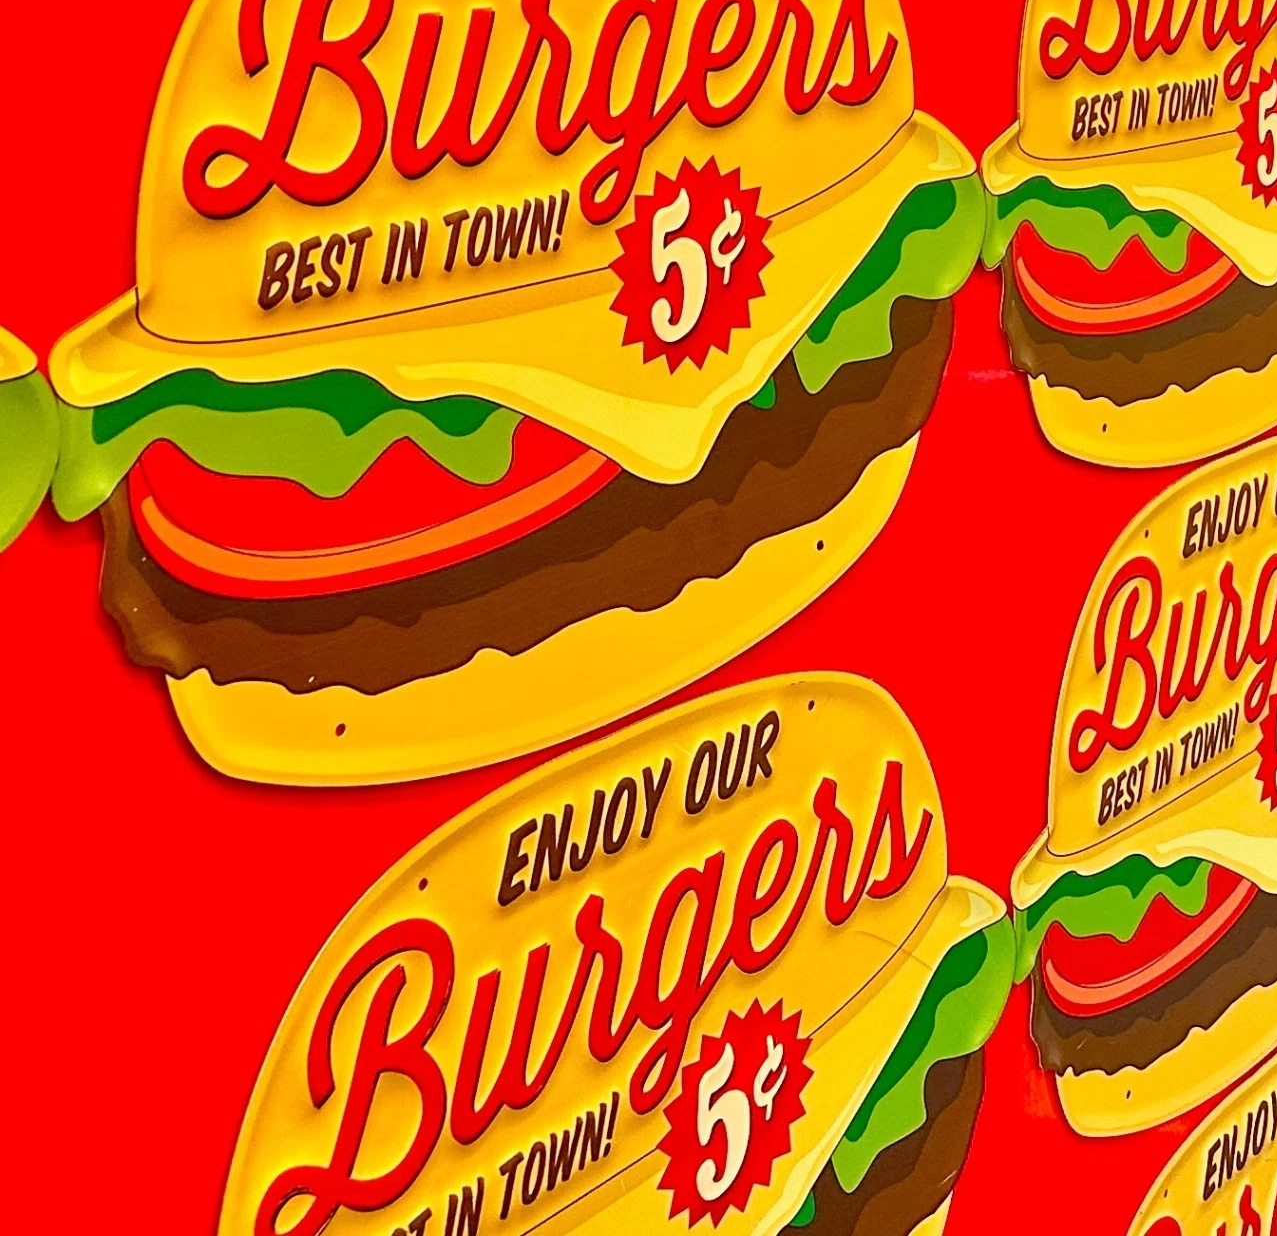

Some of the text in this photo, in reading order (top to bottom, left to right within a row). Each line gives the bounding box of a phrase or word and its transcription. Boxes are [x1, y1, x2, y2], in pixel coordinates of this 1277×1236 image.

[1072, 75, 1218, 141] BEST IN TOWN!
[258, 191, 570, 310] BEST IN TOWN!
[651, 189, 745, 341] 5¢
[1182, 473, 1268, 559] ENJOY
[498, 712, 781, 906] ENJOY OUR
[1098, 703, 1240, 826] BEST IN TOWN!
[256, 761, 933, 1236] Burgers
[499, 1092, 619, 1219] TOWN!
[697, 1035, 786, 1200] 5¢
